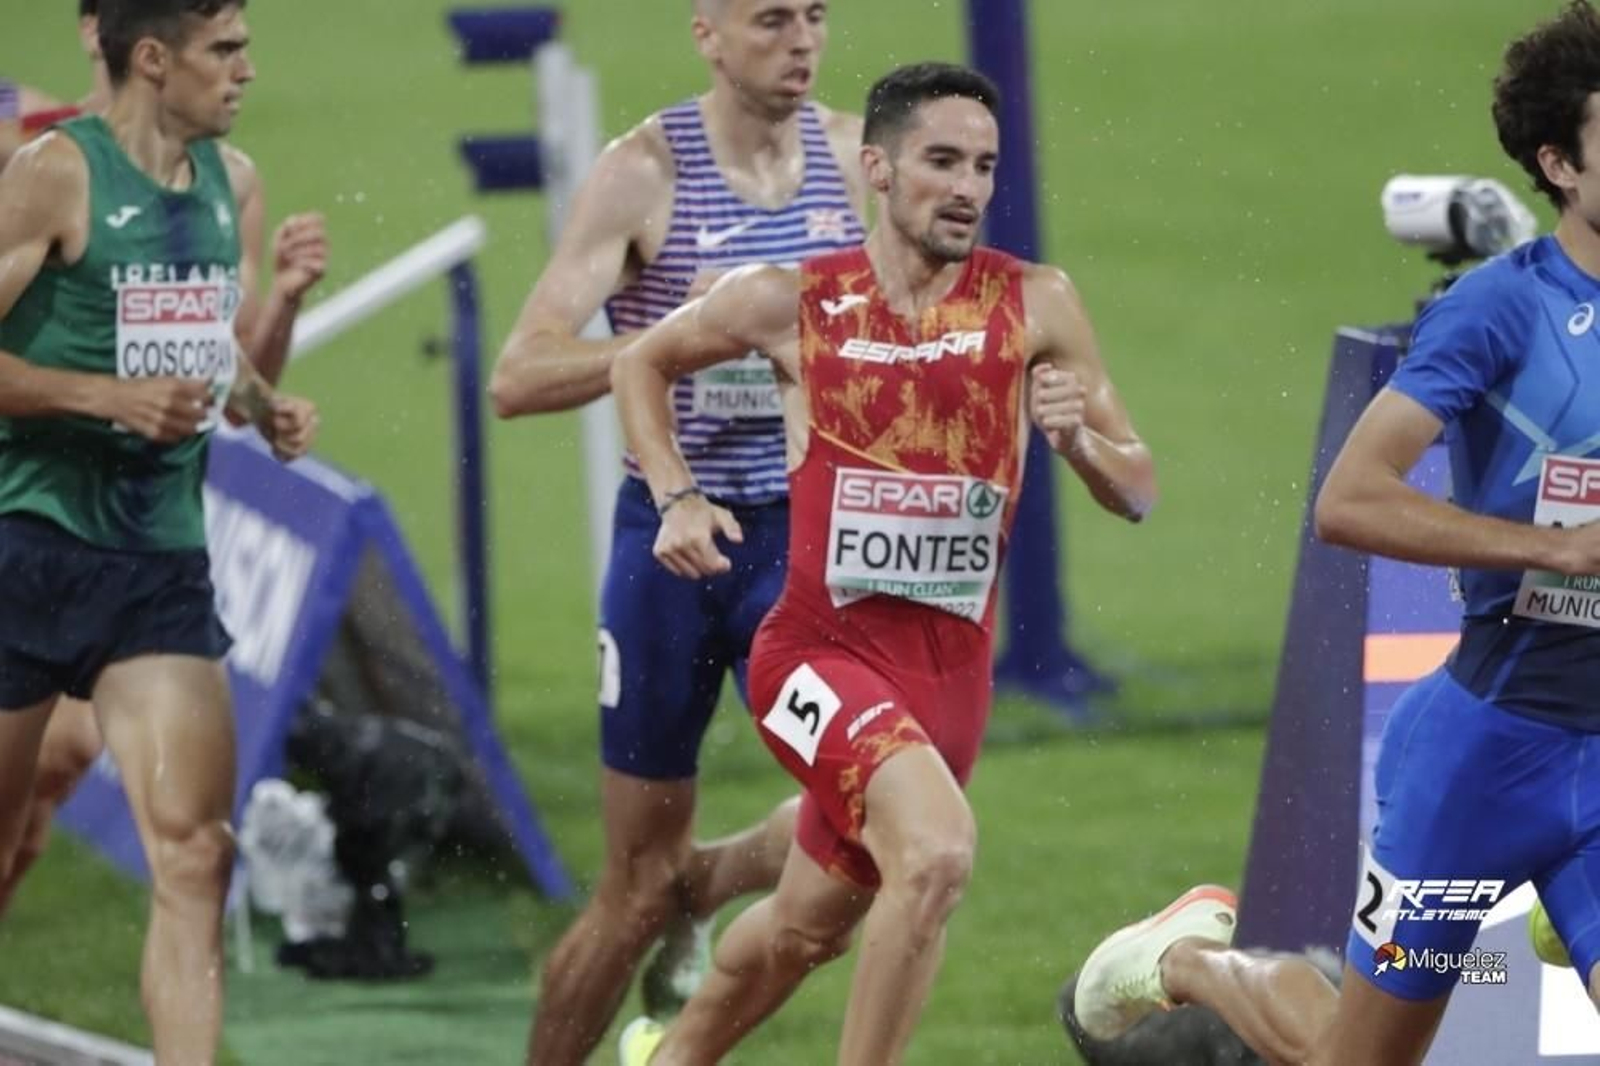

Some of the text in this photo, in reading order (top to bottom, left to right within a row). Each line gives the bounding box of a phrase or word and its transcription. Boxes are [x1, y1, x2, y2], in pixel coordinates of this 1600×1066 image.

[837, 330, 987, 365] ESPAÑA
[841, 477, 960, 513] SPAR
[834, 528, 991, 572] FONTES
[787, 688, 821, 737] 5
[1357, 870, 1384, 935] 2
